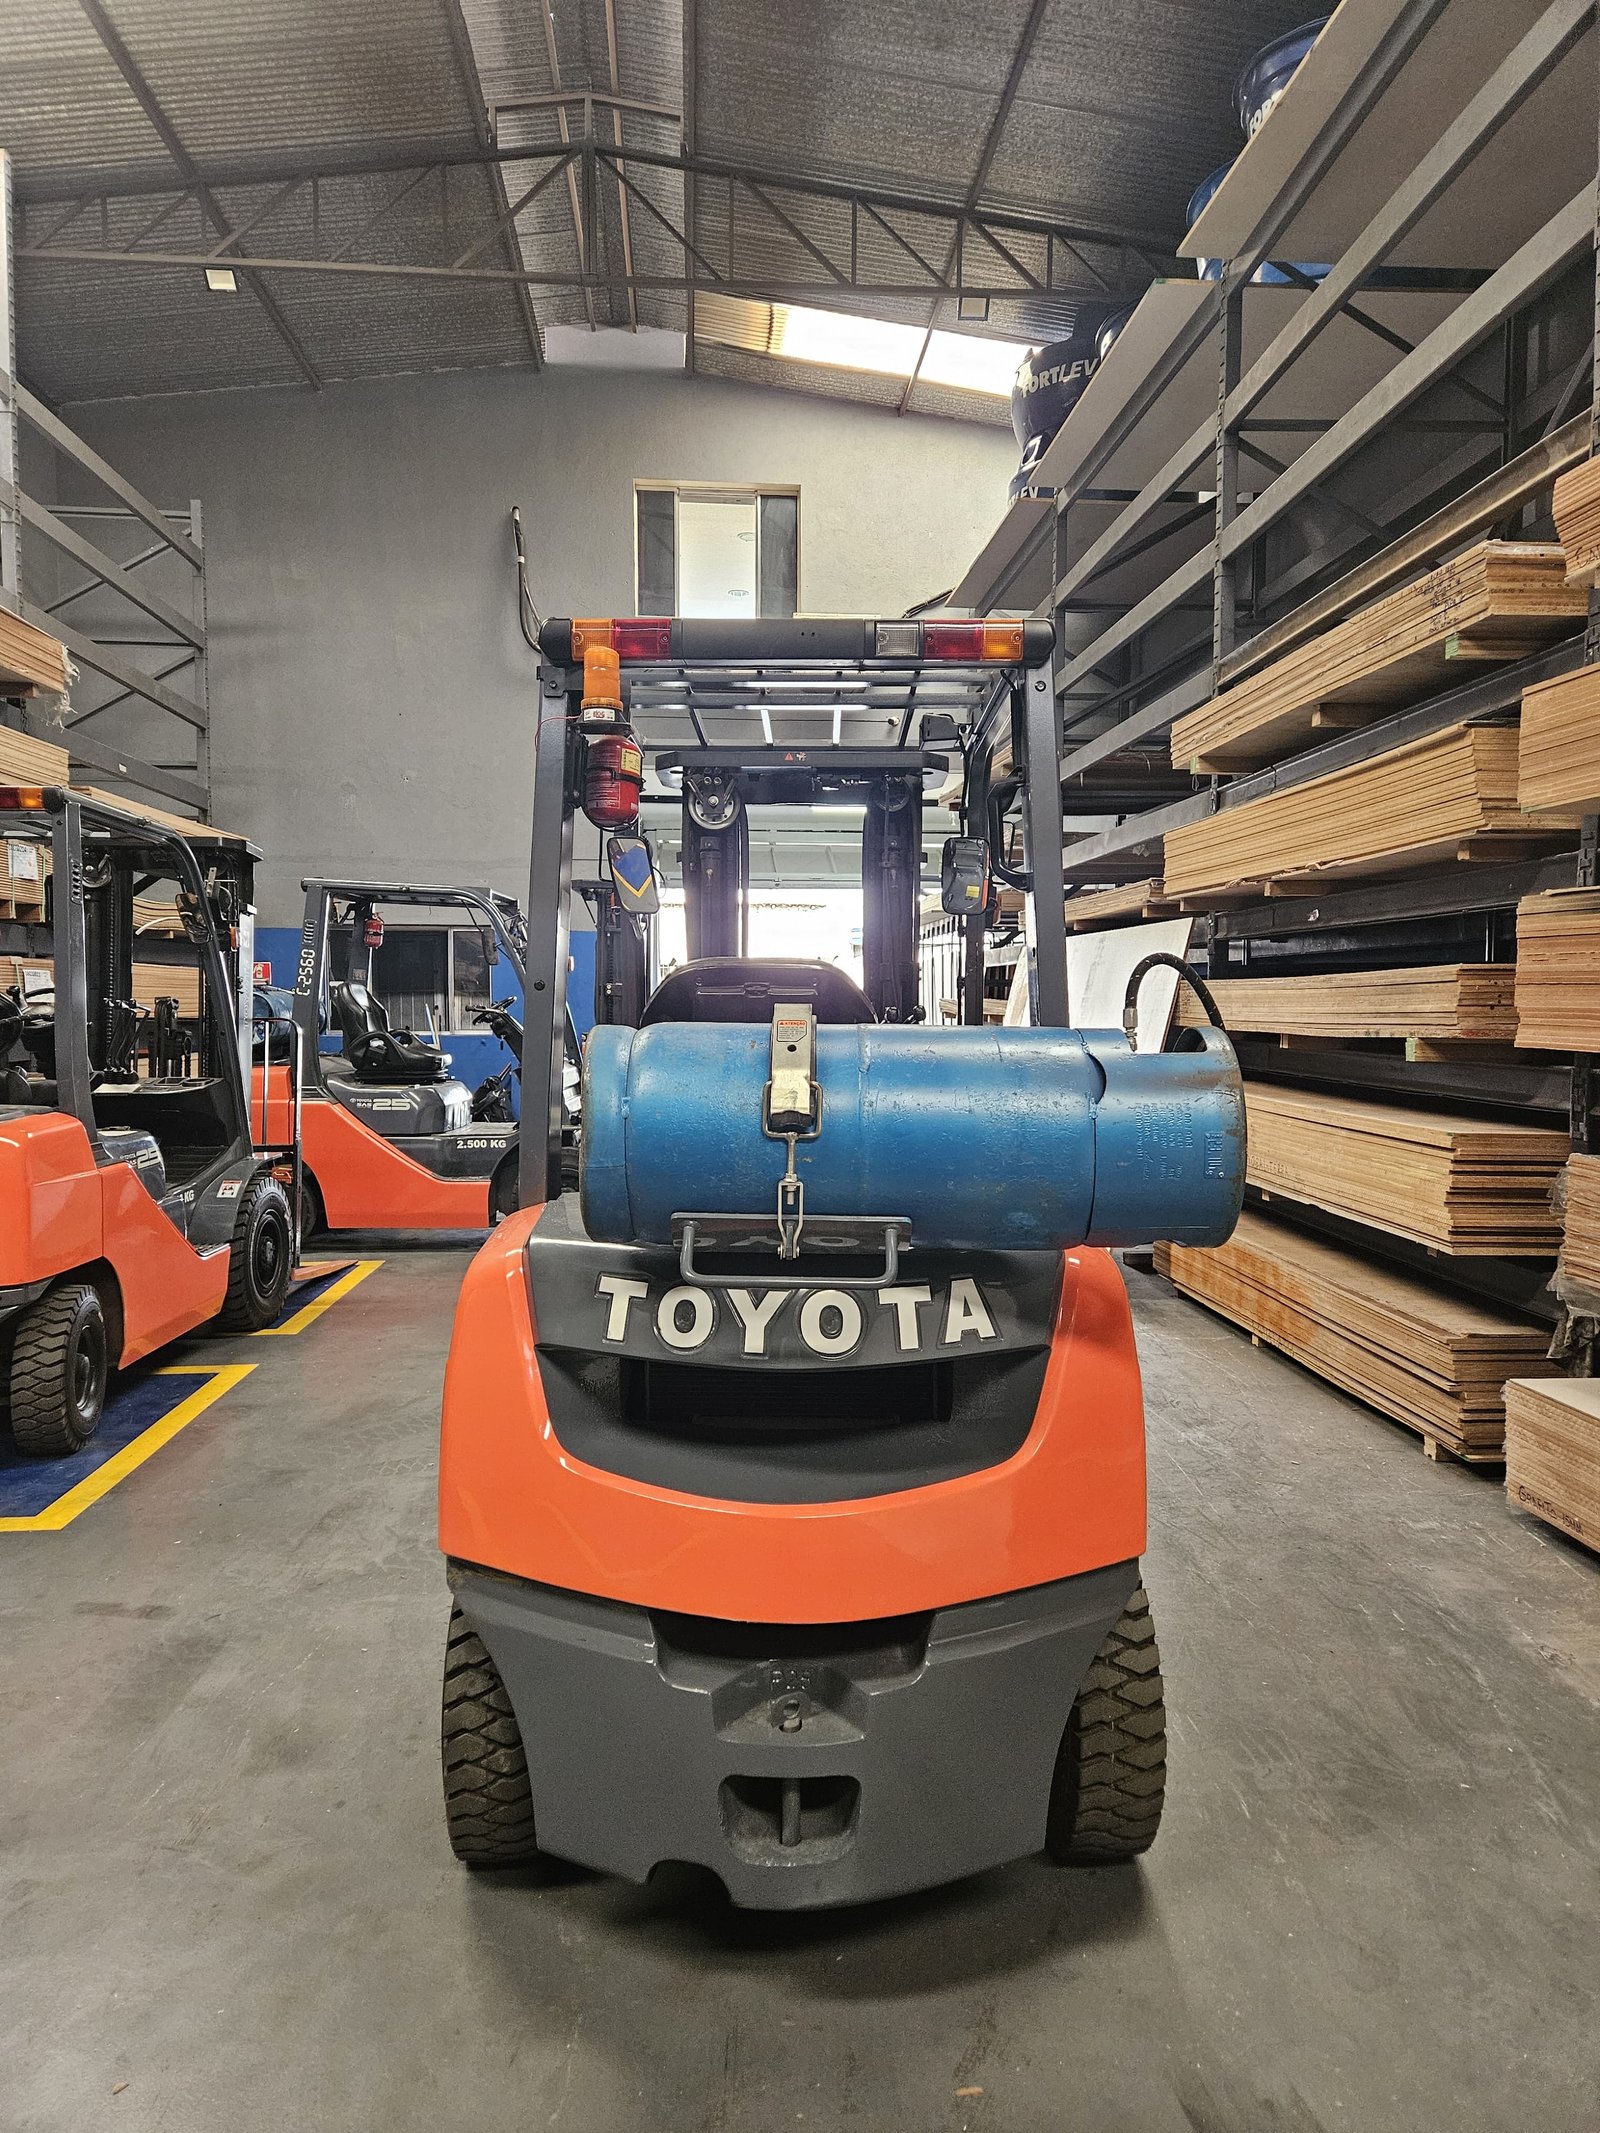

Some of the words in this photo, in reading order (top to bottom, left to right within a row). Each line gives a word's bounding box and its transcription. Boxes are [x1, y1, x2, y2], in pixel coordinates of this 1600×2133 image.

[1021, 358, 1099, 398] FORTLEV
[373, 1098, 410, 1111] 25
[457, 1140, 487, 1149] 2.500
[490, 1140, 507, 1148] KG
[184, 1190, 195, 1203] KG
[598, 1275, 998, 1355] TOYOTA
